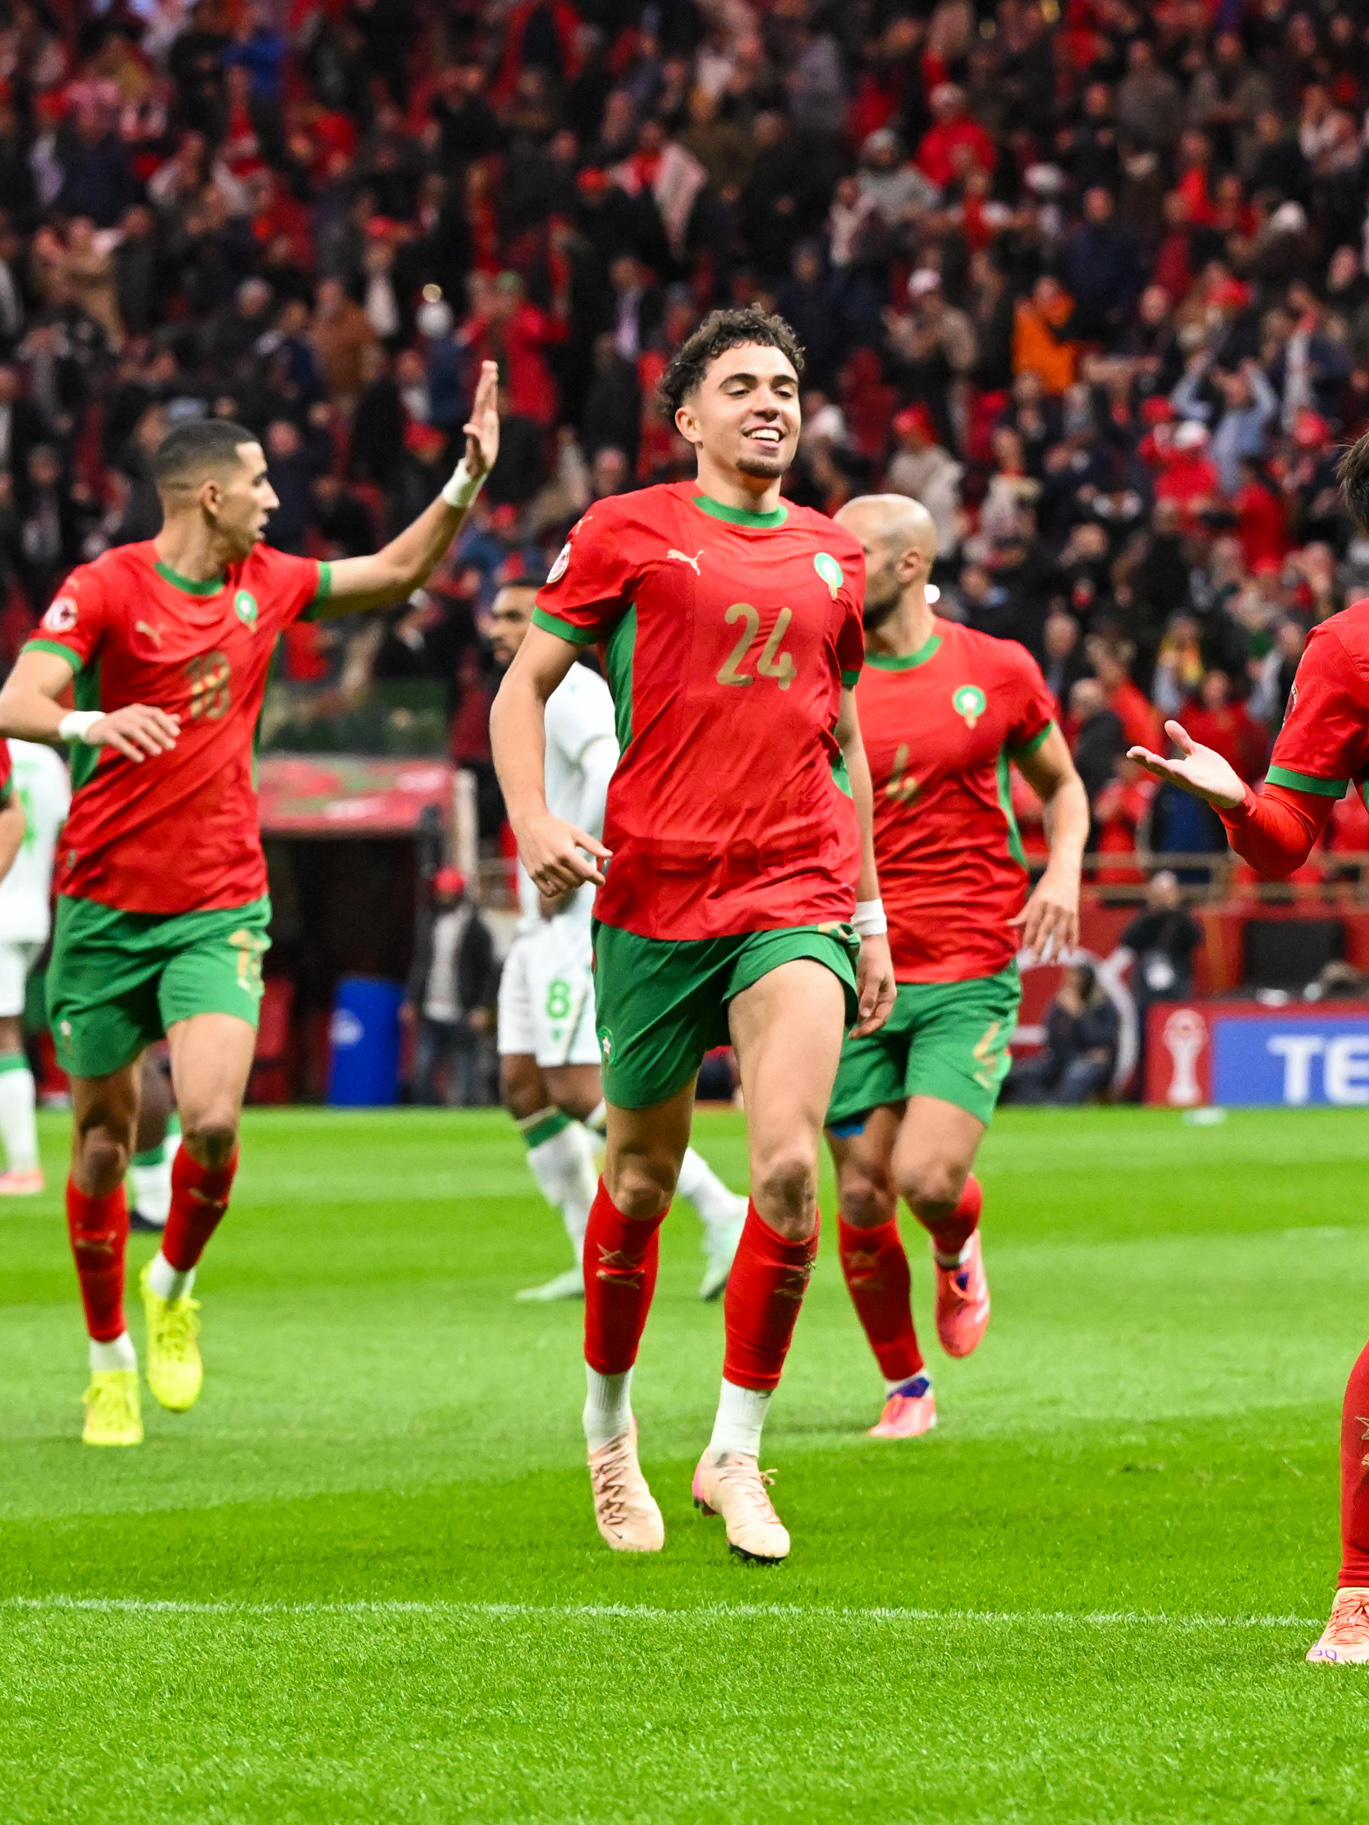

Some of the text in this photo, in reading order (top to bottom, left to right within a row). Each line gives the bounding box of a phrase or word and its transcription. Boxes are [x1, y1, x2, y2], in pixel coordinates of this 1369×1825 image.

[716, 603, 797, 690] 24
[185, 651, 231, 719] 18
[546, 977, 571, 1019] 8
